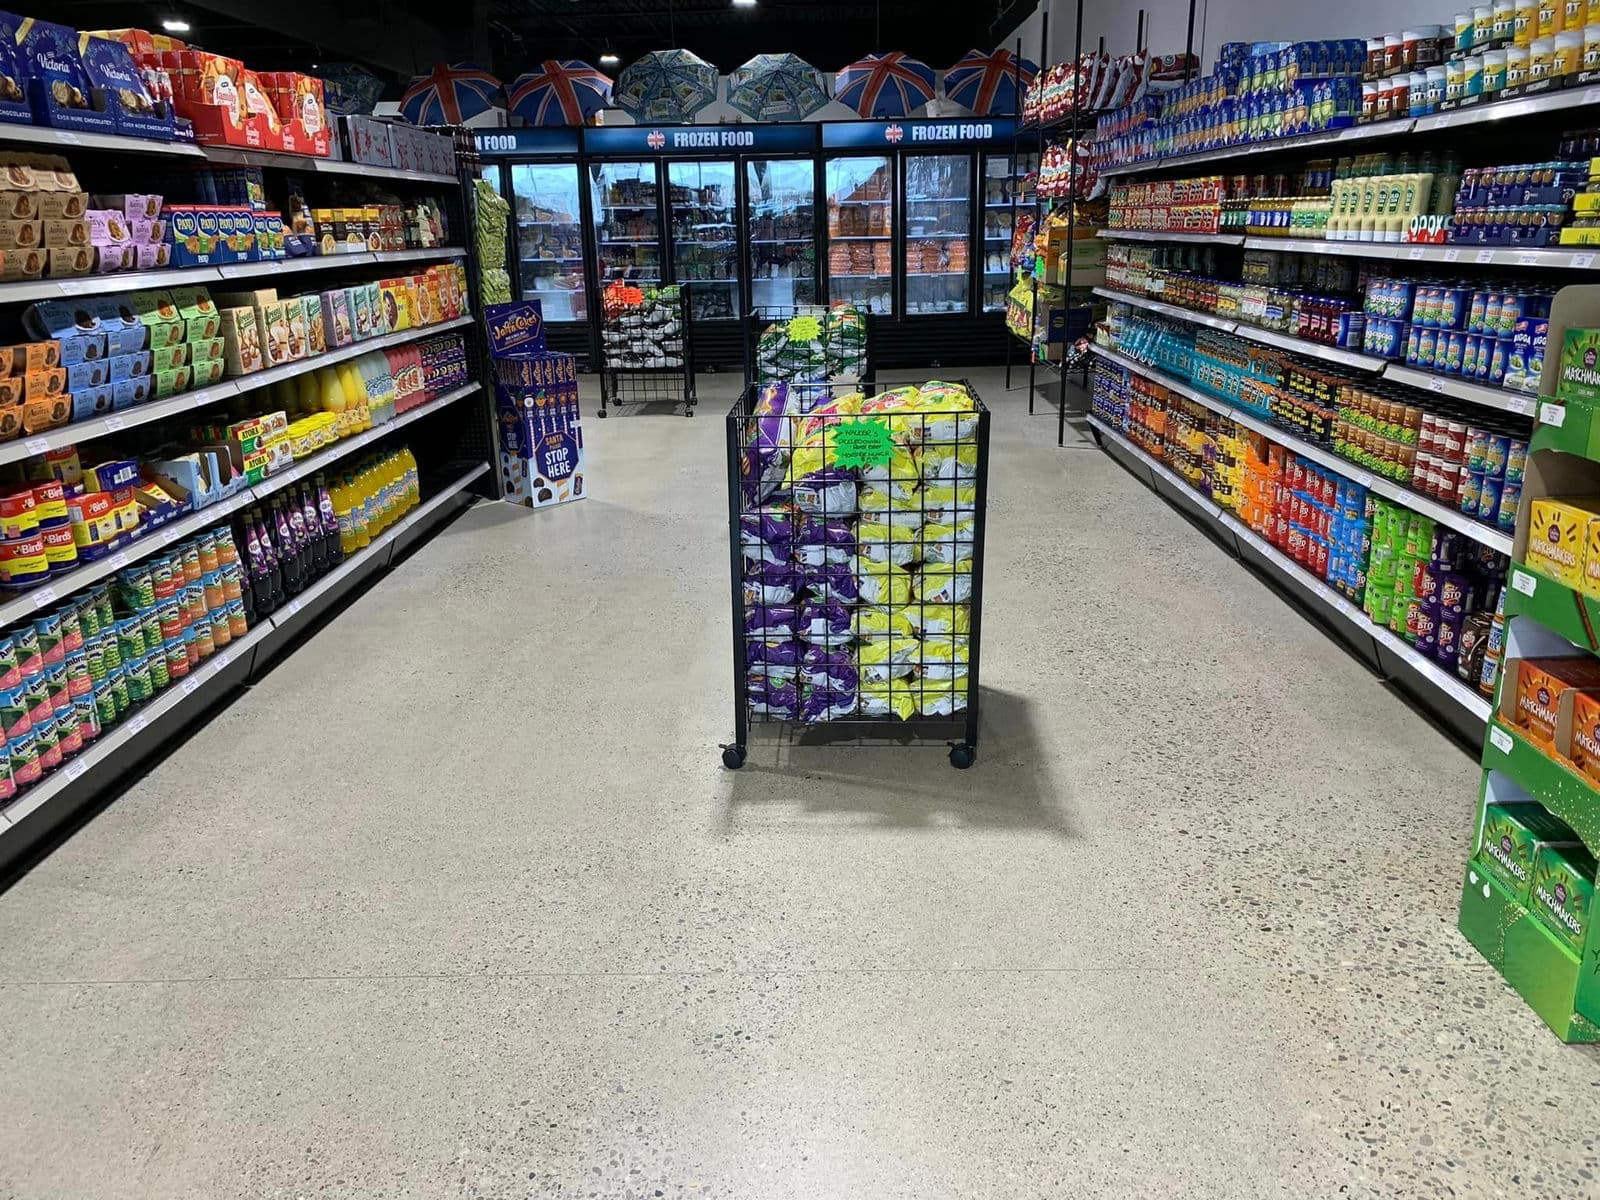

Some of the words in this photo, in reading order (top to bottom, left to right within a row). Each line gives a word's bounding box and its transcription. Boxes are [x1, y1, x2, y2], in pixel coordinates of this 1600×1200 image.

[37, 53, 70, 73] Victoria
[100, 62, 131, 82] Victoria
[674, 132, 719, 147] FROZEN
[721, 131, 754, 146] FOOD
[912, 125, 957, 140] FROZEN
[960, 123, 993, 139] FOOD
[484, 135, 517, 150] FOOD
[545, 447, 569, 465] STOP
[547, 460, 571, 478] HERE
[1484, 838, 1527, 881] MATCHMAKERS
[1536, 884, 1582, 935] MATCHMAKERS
